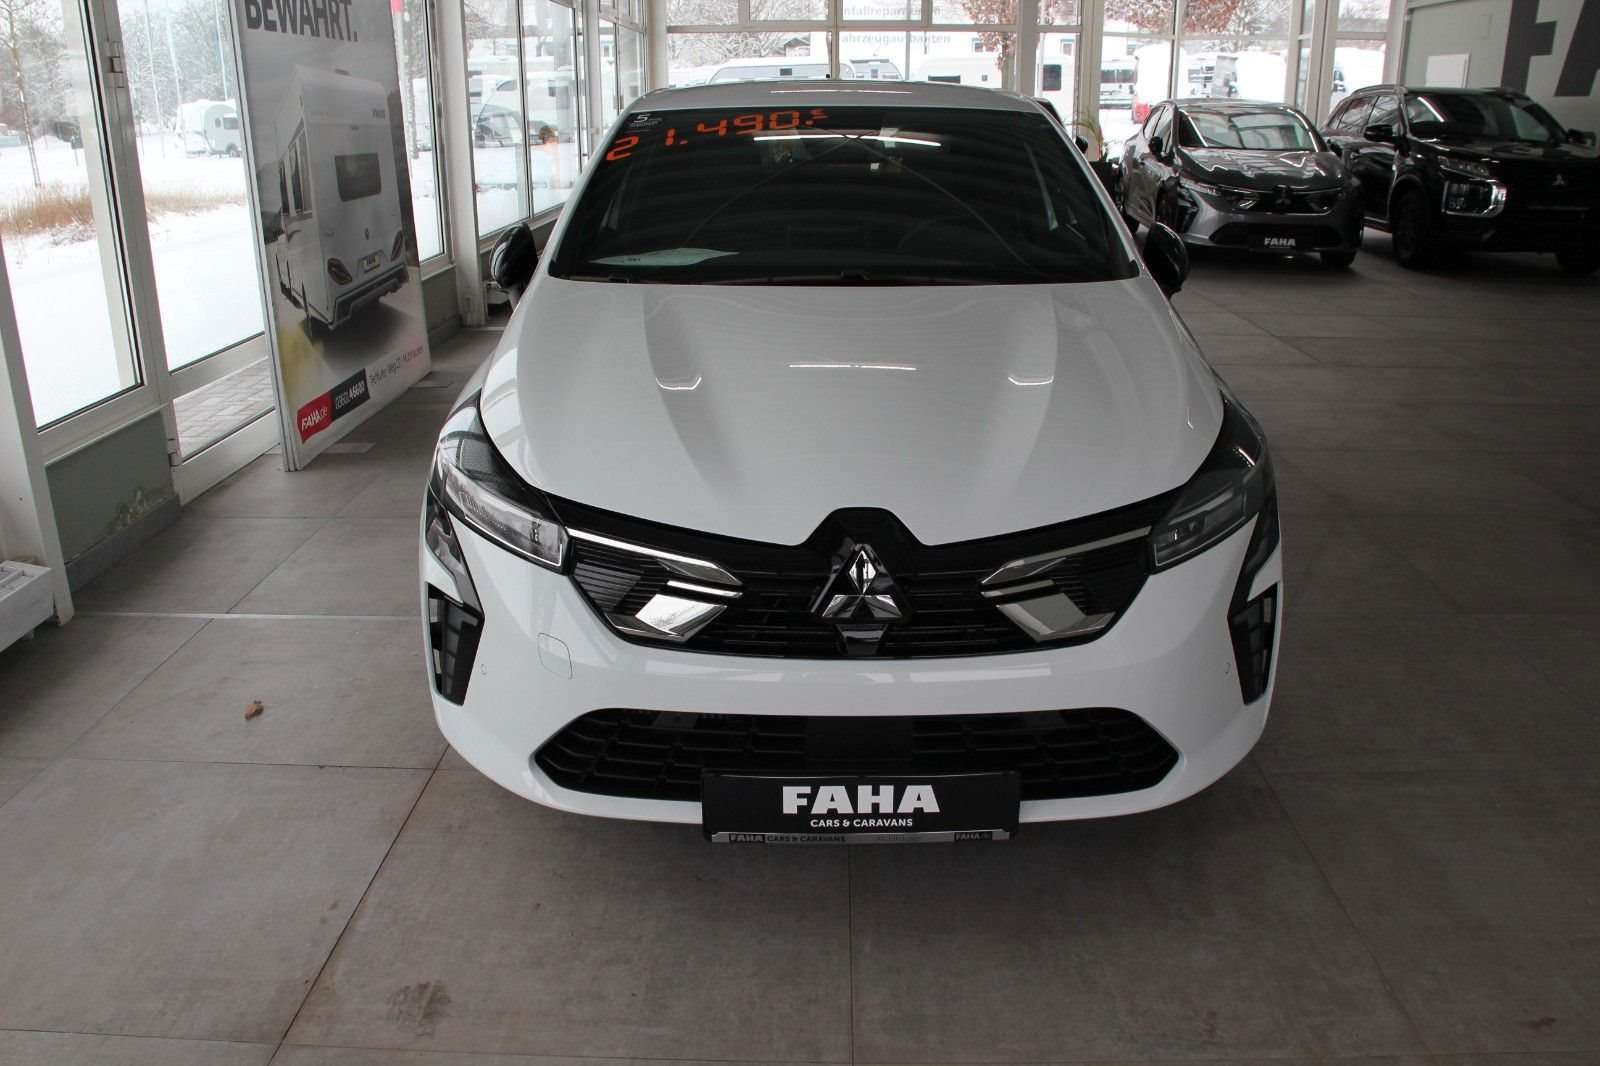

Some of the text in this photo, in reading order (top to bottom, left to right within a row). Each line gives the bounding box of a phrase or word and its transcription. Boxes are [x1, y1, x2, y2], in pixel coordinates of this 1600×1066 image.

[1264, 237, 1296, 247] FAHA
[782, 785, 940, 814] FAHA
[810, 818, 913, 828] CARS & CARAVANS
